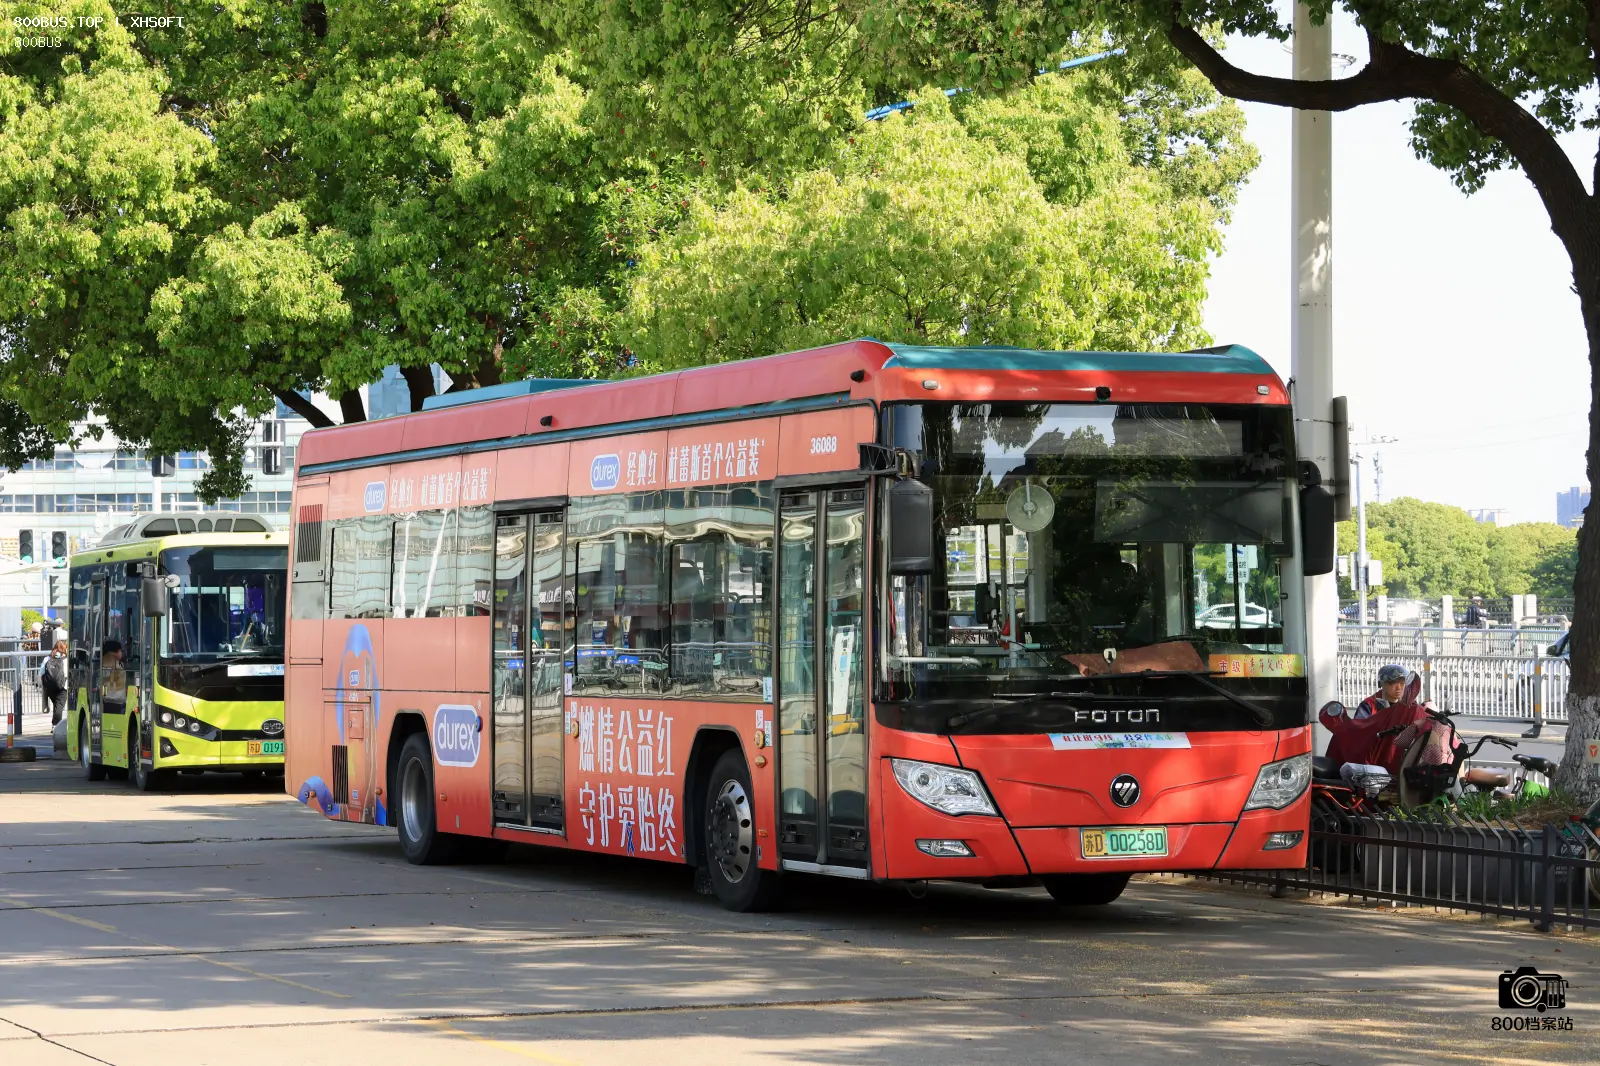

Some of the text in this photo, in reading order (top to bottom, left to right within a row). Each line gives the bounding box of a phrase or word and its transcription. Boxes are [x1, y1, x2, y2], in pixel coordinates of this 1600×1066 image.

[810, 436, 837, 454] 36088
[593, 462, 617, 482] durex
[626, 450, 658, 486] 经典红
[366, 487, 385, 505] durex
[1074, 709, 1160, 723] FOTON
[263, 722, 282, 730] BYD
[437, 713, 477, 757] durex
[578, 705, 675, 776] 燃情公益红
